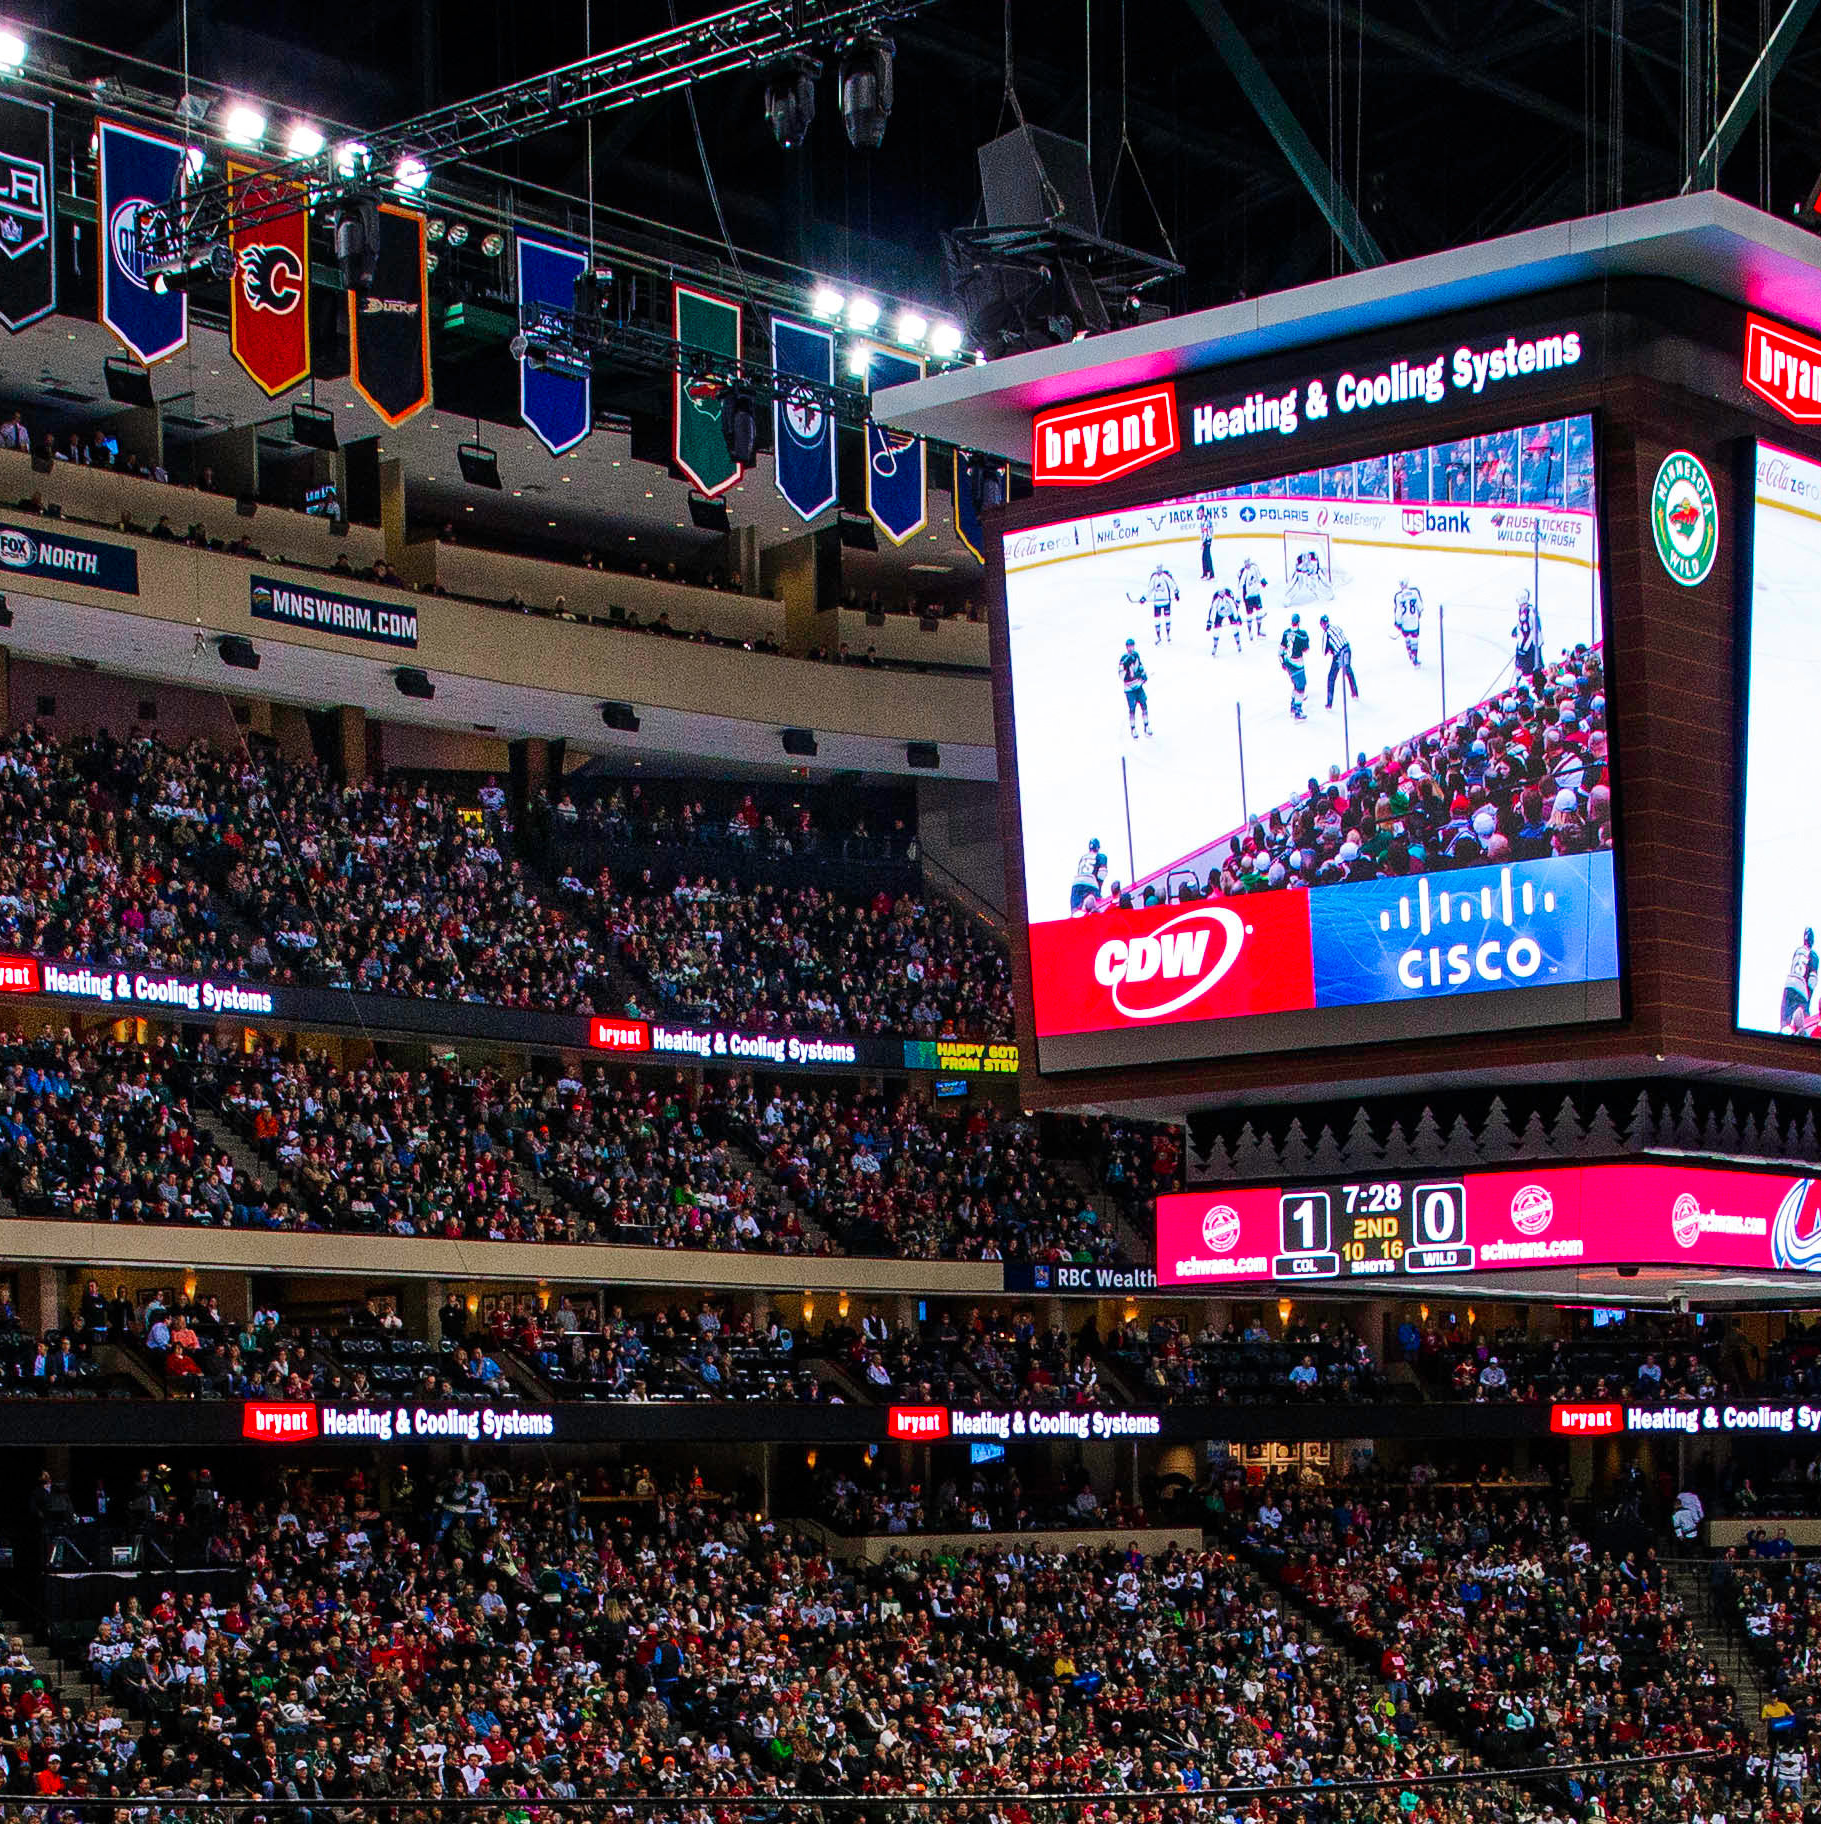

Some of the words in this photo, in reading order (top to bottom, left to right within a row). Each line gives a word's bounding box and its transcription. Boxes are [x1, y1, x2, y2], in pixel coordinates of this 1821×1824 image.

[1044, 405, 1157, 470] bryant
[1193, 382, 1298, 446] Heating
[1305, 380, 1328, 420] &
[1336, 356, 1445, 411] Cooling
[1451, 331, 1582, 394] Systems
[1658, 460, 1713, 516] MINNESOTA
[1168, 509, 1194, 524] JACK
[1259, 508, 1309, 522] POLARIS
[1506, 515, 1535, 529] RUSH
[1541, 520, 1582, 535] TICKETS
[0, 535, 30, 557] FOX
[1097, 527, 1139, 544] NHL.COM
[38, 542, 99, 575] NORTH
[1669, 549, 1700, 577] WILD
[272, 589, 418, 640] MNSWARM.COM
[1094, 929, 1210, 987] CDW
[1397, 937, 1543, 990] CISCO
[44, 967, 112, 1001] Heating
[116, 974, 132, 999] &
[135, 976, 199, 1011] Cooling
[202, 982, 273, 1013] Systems
[598, 1024, 641, 1047] bryant
[653, 1027, 711, 1057] Heating
[714, 1033, 727, 1055] &
[729, 1034, 785, 1061] Cooling
[788, 1038, 856, 1064] Systems
[936, 1042, 985, 1058] HAPPY
[940, 1056, 981, 1071] FROM
[1292, 1200, 1314, 1248] 1
[1341, 1183, 1402, 1215] 7:28
[1423, 1191, 1456, 1242] 0
[1353, 1218, 1399, 1240] 2ND
[1291, 1258, 1319, 1273] COL
[1351, 1258, 1396, 1274] SHOTS
[1422, 1251, 1458, 1266] WILD
[1341, 1242, 1365, 1262] 10
[1380, 1240, 1404, 1259] 16
[1479, 1238, 1584, 1262] schwans.com
[1057, 1268, 1091, 1287] RBC
[1096, 1268, 1158, 1288] Wealth
[1175, 1255, 1268, 1277] schwans.com
[256, 1410, 308, 1434] bryant
[323, 1408, 392, 1440] Heating
[395, 1408, 411, 1434] &
[414, 1408, 479, 1440] Cooling
[482, 1407, 554, 1440] Systems
[897, 1412, 940, 1434] bryant
[952, 1411, 1010, 1439] Heating
[1012, 1411, 1026, 1434] &
[1029, 1411, 1090, 1439] Cooling
[1092, 1410, 1160, 1439] Systems
[1561, 1410, 1613, 1430] bryant
[1628, 1407, 1700, 1433] Heating
[1702, 1406, 1719, 1429] &
[1723, 1406, 1793, 1431] Cooling
